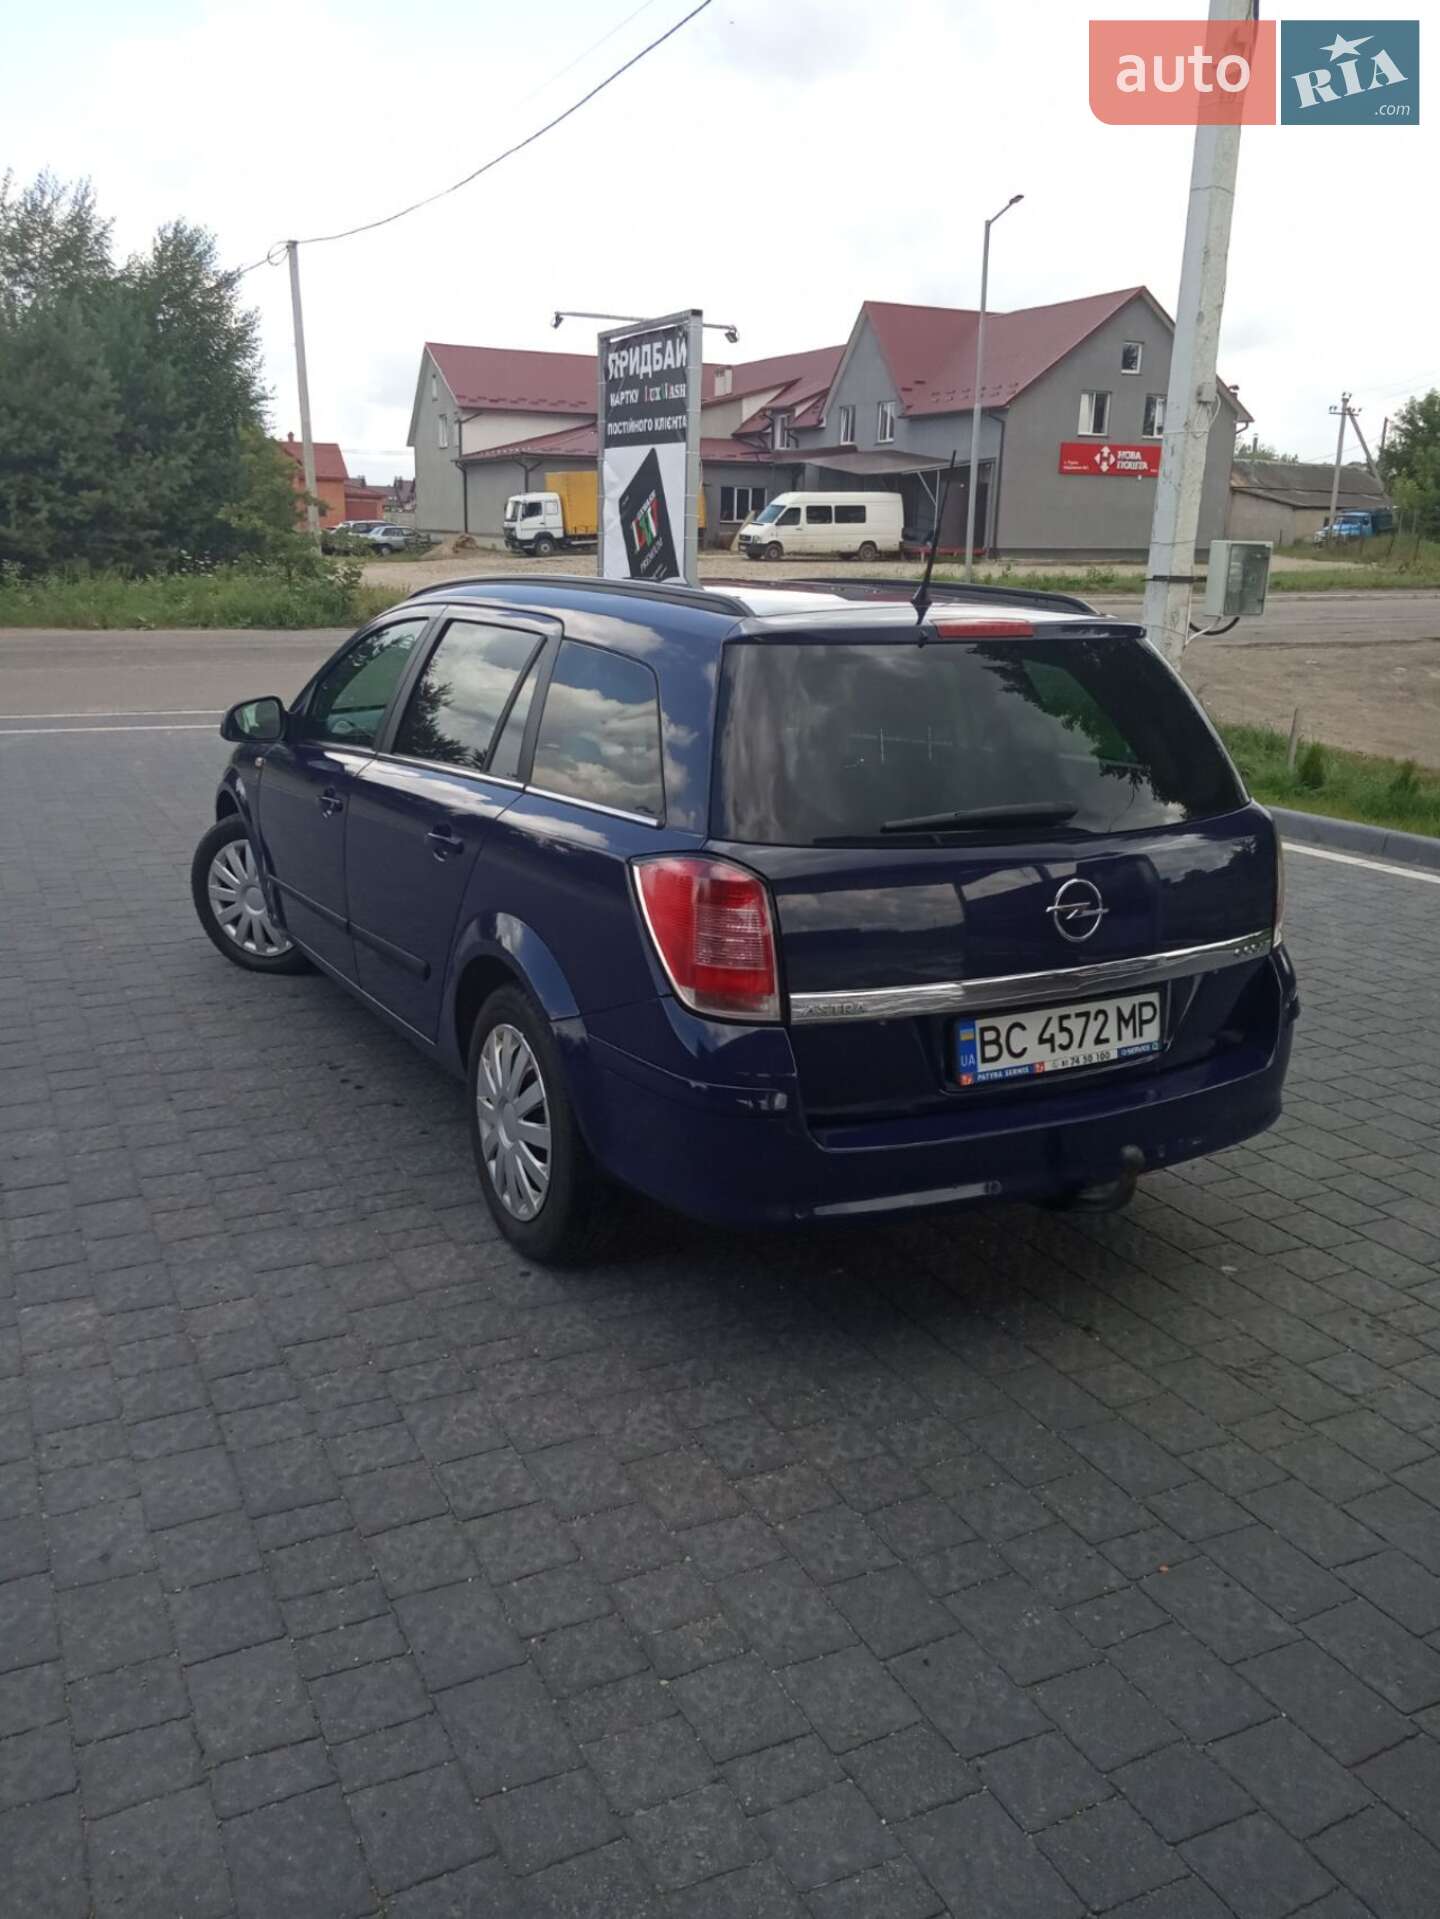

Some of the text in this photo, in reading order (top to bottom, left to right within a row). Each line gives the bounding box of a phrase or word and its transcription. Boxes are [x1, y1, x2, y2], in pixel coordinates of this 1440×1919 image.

[610, 389, 639, 407] КАРТКУ
[979, 1001, 1158, 1064] BC 4572 MP
[960, 1054, 976, 1068] UA
